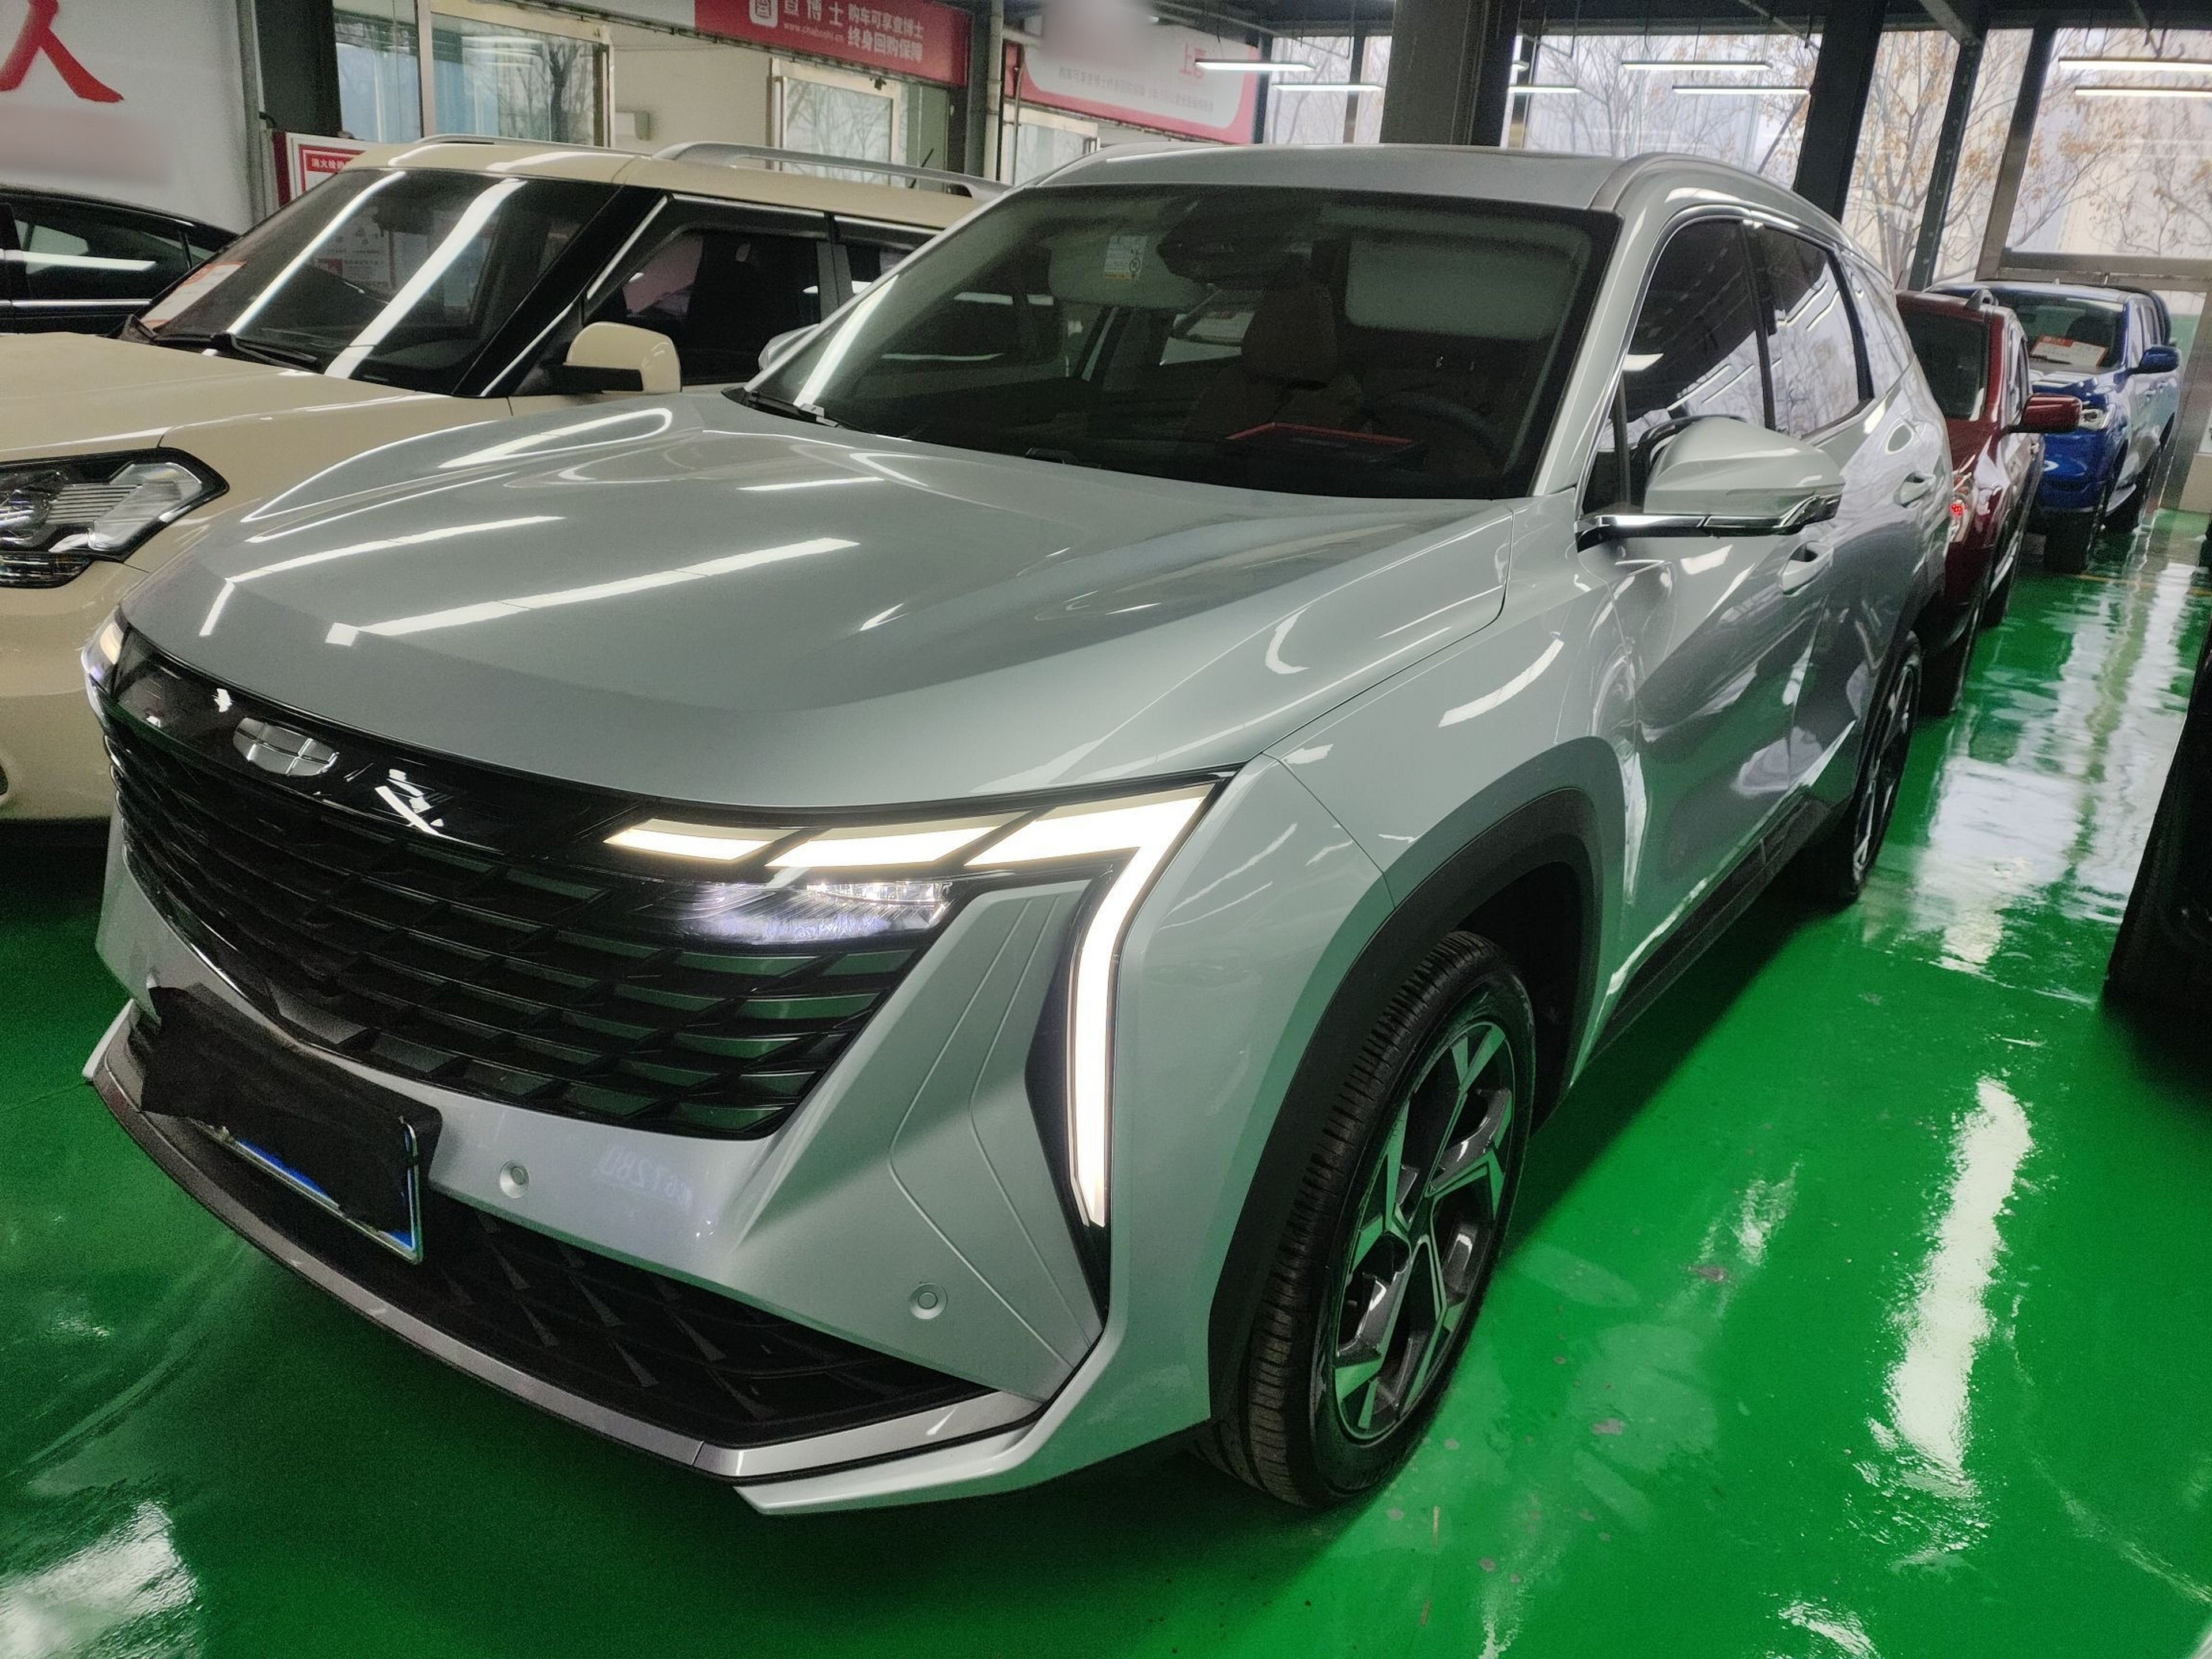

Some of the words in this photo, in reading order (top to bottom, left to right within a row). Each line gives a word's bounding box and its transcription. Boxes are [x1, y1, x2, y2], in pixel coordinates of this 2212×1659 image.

[848, 3, 924, 39] 购车可享查博士
[848, 25, 923, 63] 终身回购保障
